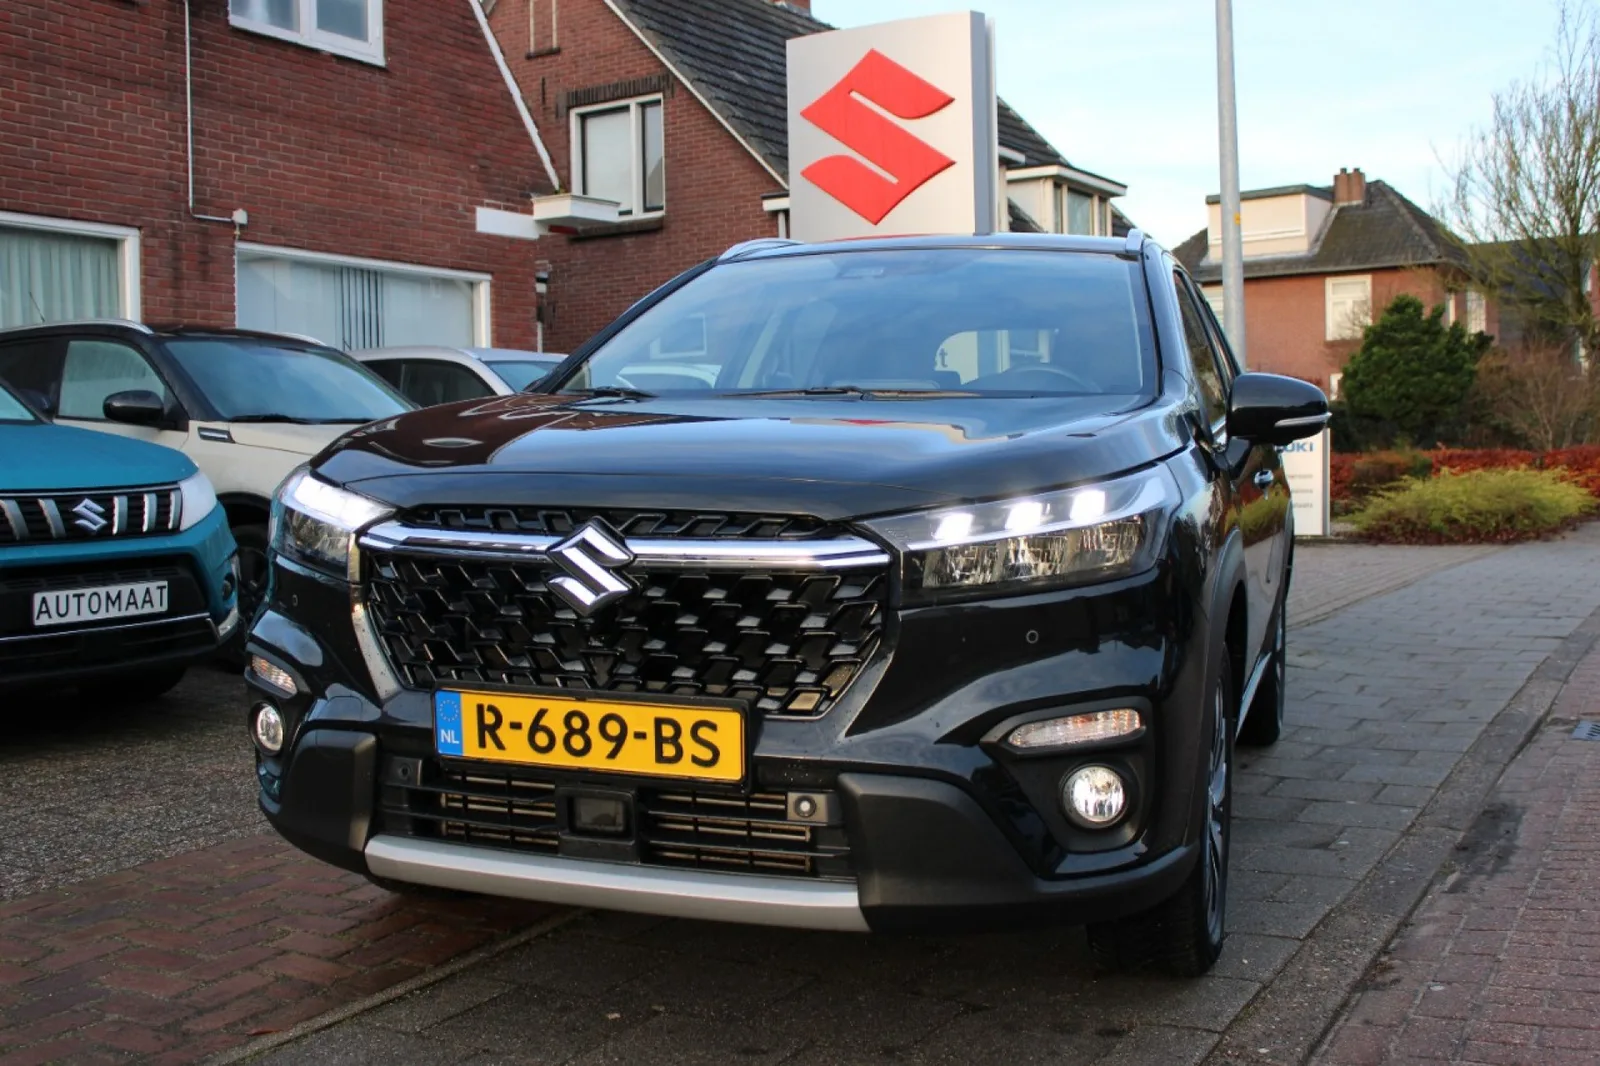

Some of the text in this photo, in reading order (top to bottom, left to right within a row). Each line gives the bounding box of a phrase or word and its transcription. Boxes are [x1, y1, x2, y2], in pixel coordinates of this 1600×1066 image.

[1284, 442, 1314, 452] UKI
[36, 586, 167, 620] AUTOMAAT
[441, 729, 460, 745] NL
[476, 703, 721, 768] R-689-BS
